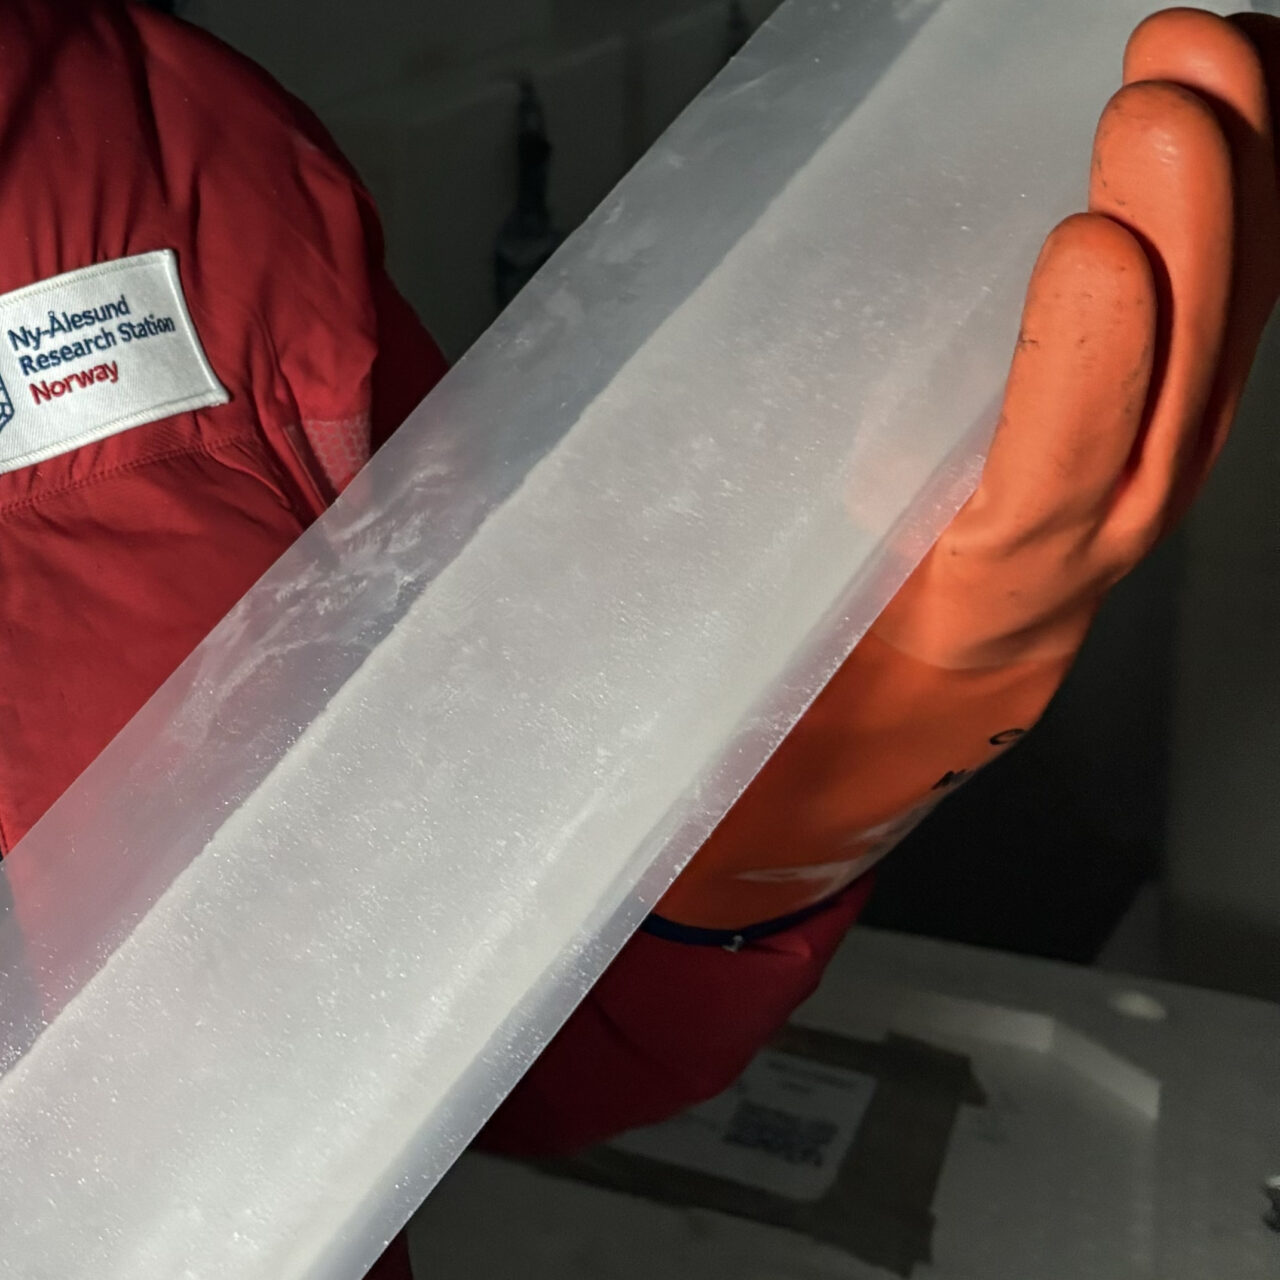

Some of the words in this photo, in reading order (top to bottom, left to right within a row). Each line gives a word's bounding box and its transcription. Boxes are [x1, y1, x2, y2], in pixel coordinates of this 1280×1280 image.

[8, 294, 132, 352] Ny-Ålesund
[19, 328, 118, 377] Research
[117, 313, 176, 344] Station
[29, 361, 120, 405] Norway
